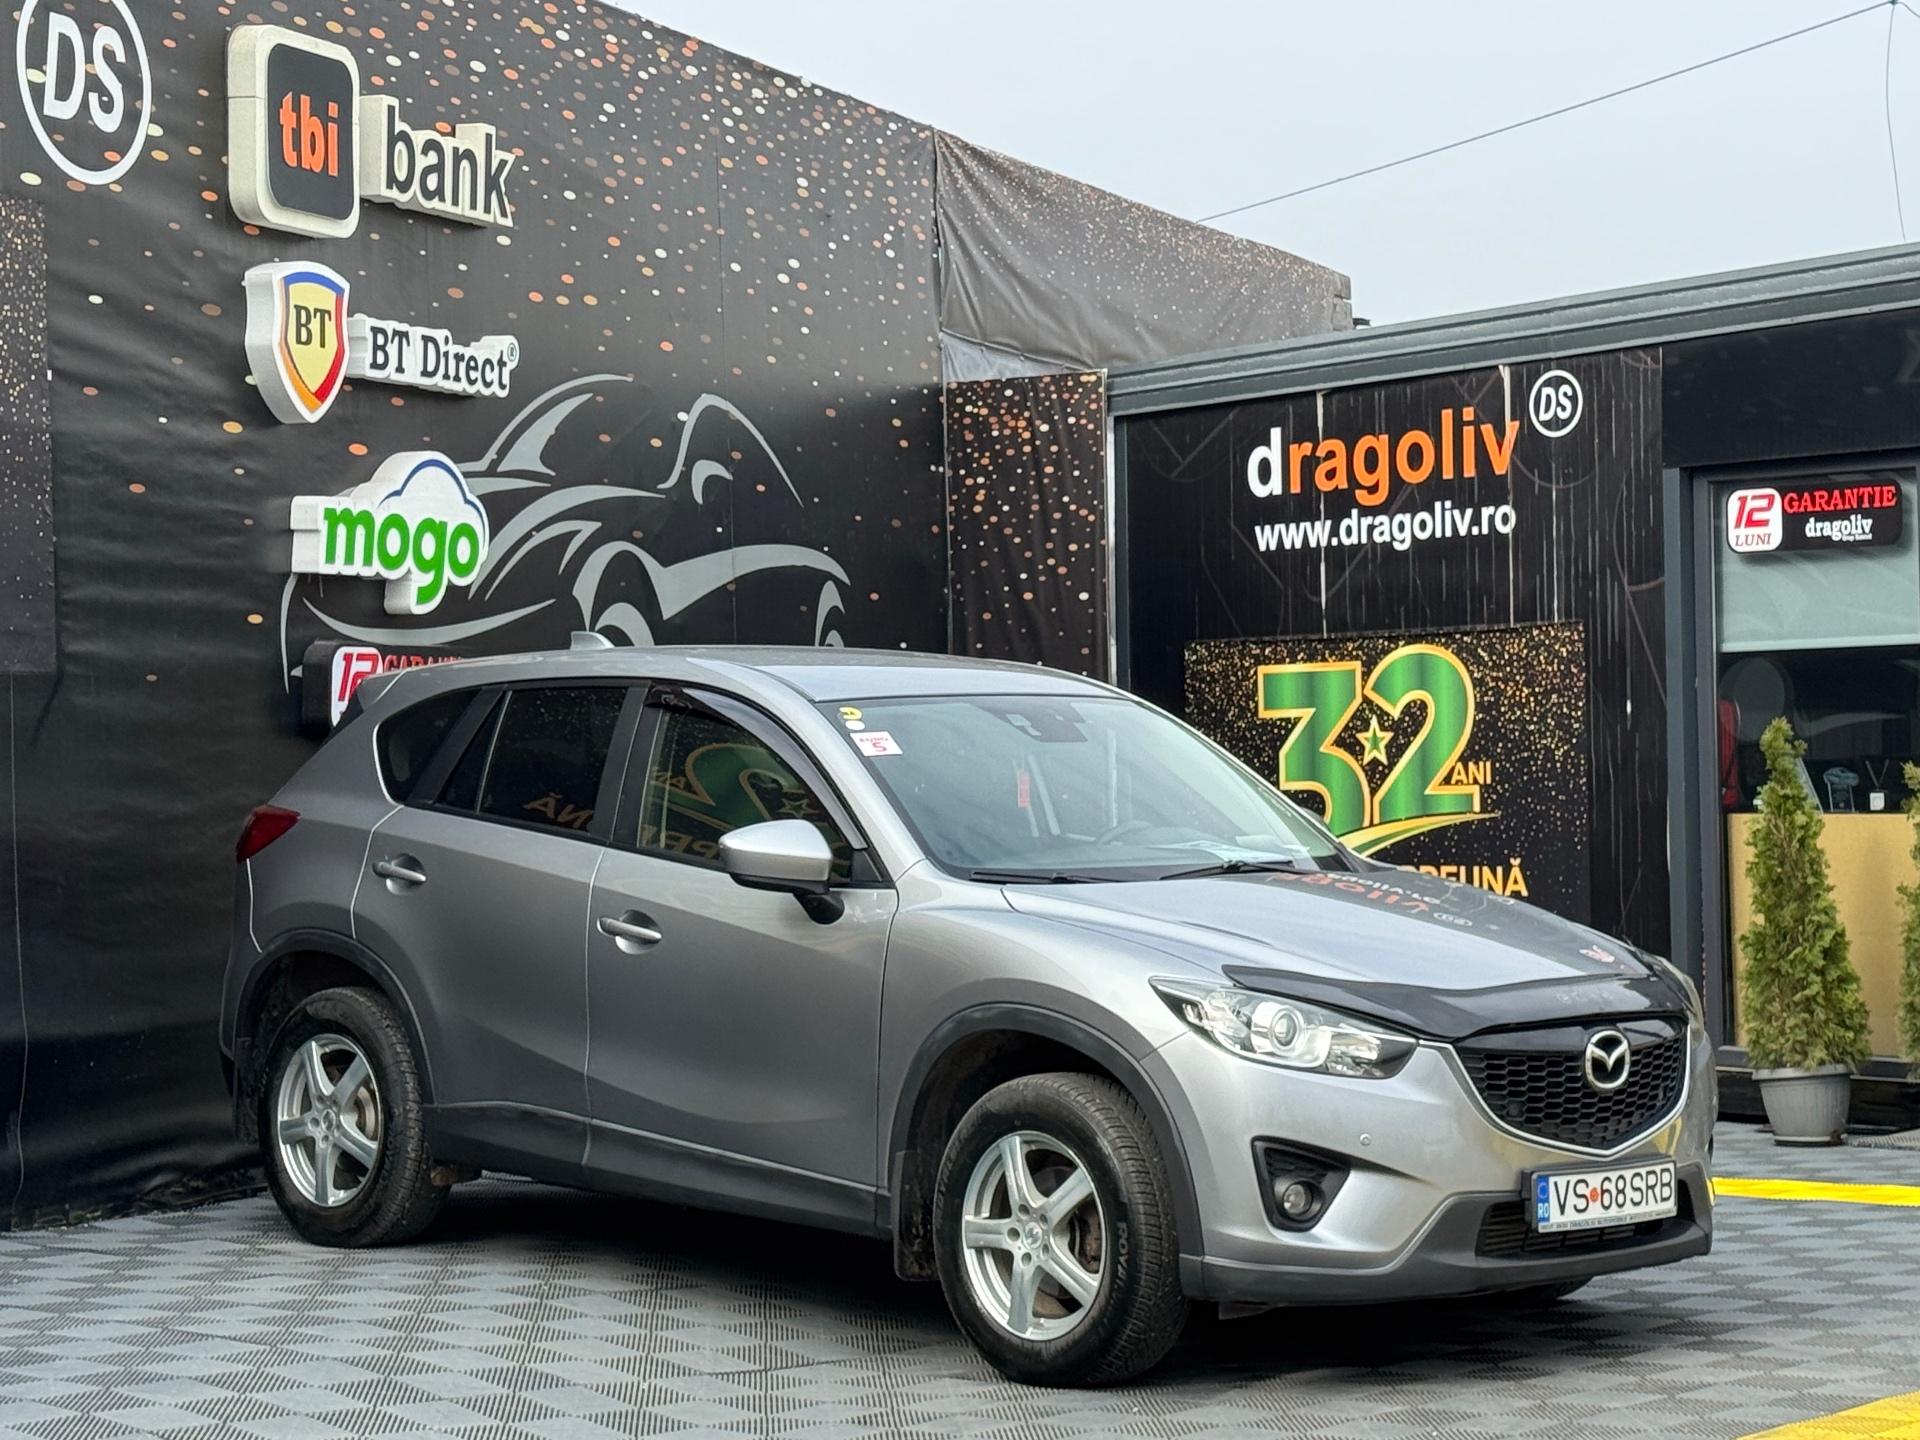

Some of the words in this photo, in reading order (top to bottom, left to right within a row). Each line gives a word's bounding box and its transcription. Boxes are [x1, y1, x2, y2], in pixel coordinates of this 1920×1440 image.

[43, 11, 126, 133] DS
[280, 90, 339, 177] tbi
[385, 104, 513, 225] bank
[294, 305, 331, 349] BT
[369, 324, 410, 374] BT
[1538, 383, 1573, 421] DS
[1246, 407, 1520, 506] dragoliv
[1254, 501, 1517, 551] www.dragoliv.ro
[1734, 494, 1775, 529] 12
[1783, 486, 1897, 514] GARANTIE
[1805, 514, 1873, 541] dragoliv
[324, 507, 479, 605] mogo
[1735, 533, 1771, 547] LUNI
[1257, 643, 1480, 837] 32
[1450, 761, 1492, 786] ANI
[1538, 1202, 1549, 1218] RO
